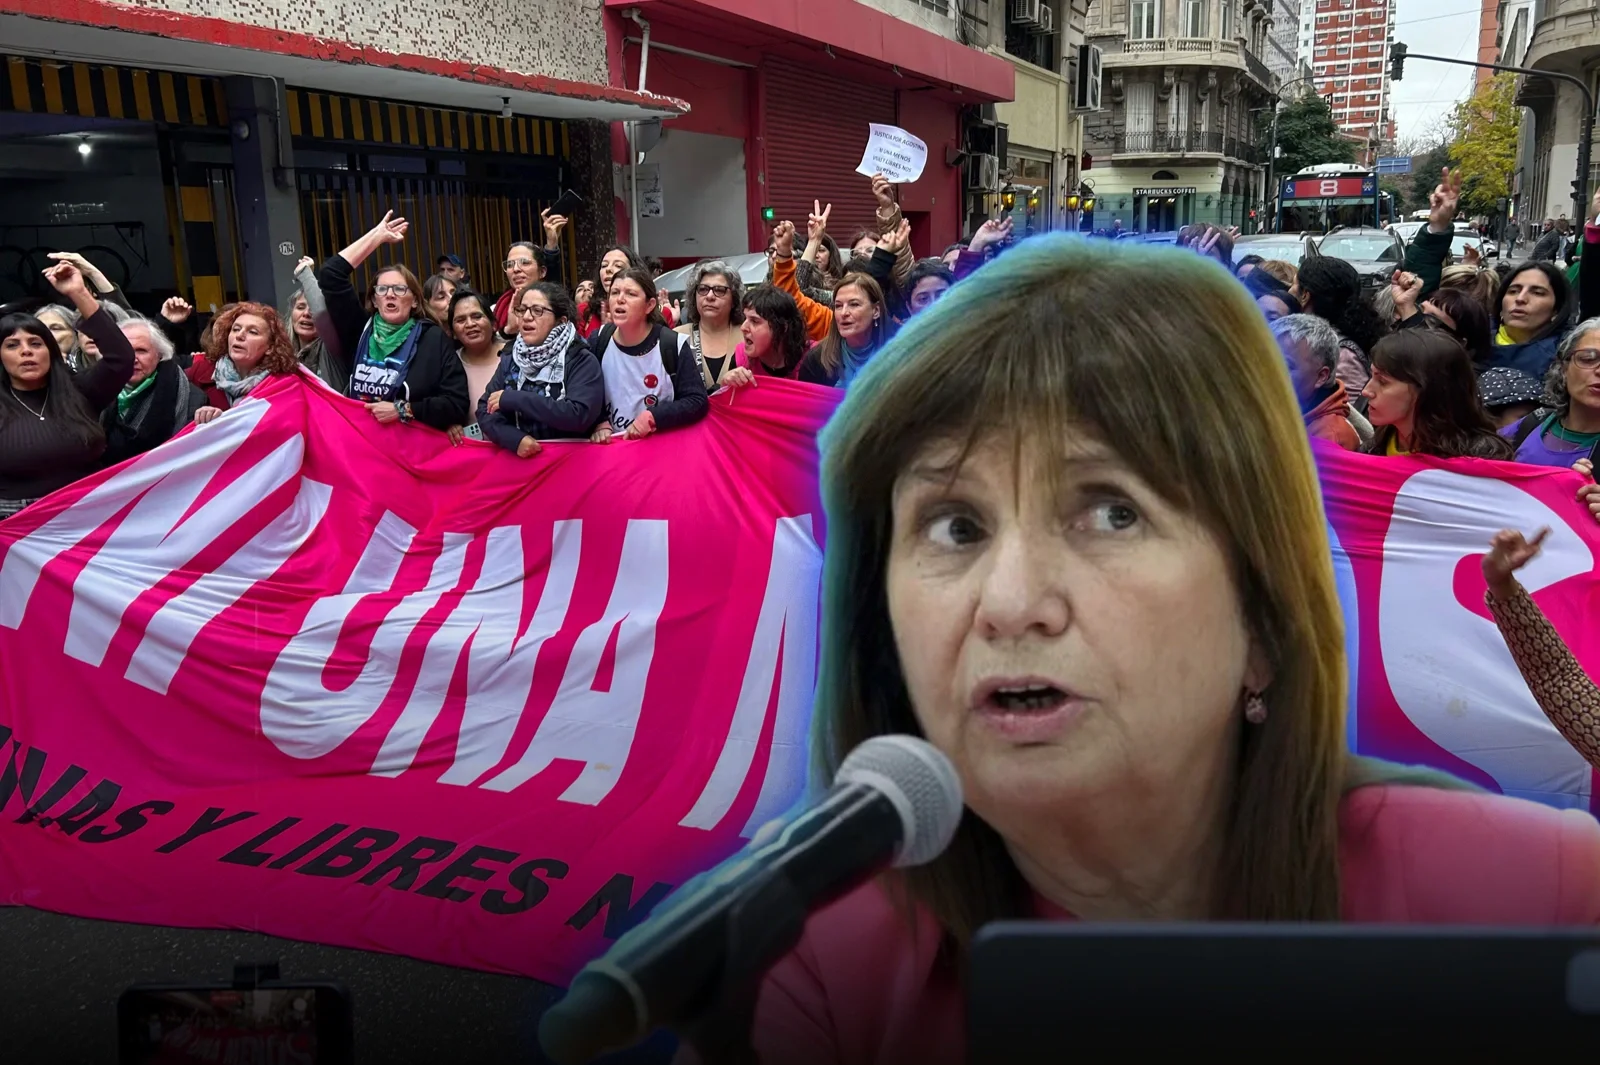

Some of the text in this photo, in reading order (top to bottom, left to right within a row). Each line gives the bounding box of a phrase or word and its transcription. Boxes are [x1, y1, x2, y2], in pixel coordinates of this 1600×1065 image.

[874, 130, 892, 140] JUSTICIA
[902, 140, 925, 152] AGOSTINA
[893, 152, 911, 163] MENOS
[886, 159, 901, 170] LIBRES
[902, 165, 912, 173] NOS
[1135, 187, 1196, 196] STARBUCKS COFFEE
[1319, 180, 1338, 196] 8
[0, 398, 333, 696] NI
[259, 508, 669, 807] UNA
[154, 806, 260, 854] Y
[217, 816, 570, 915] LIBRES
